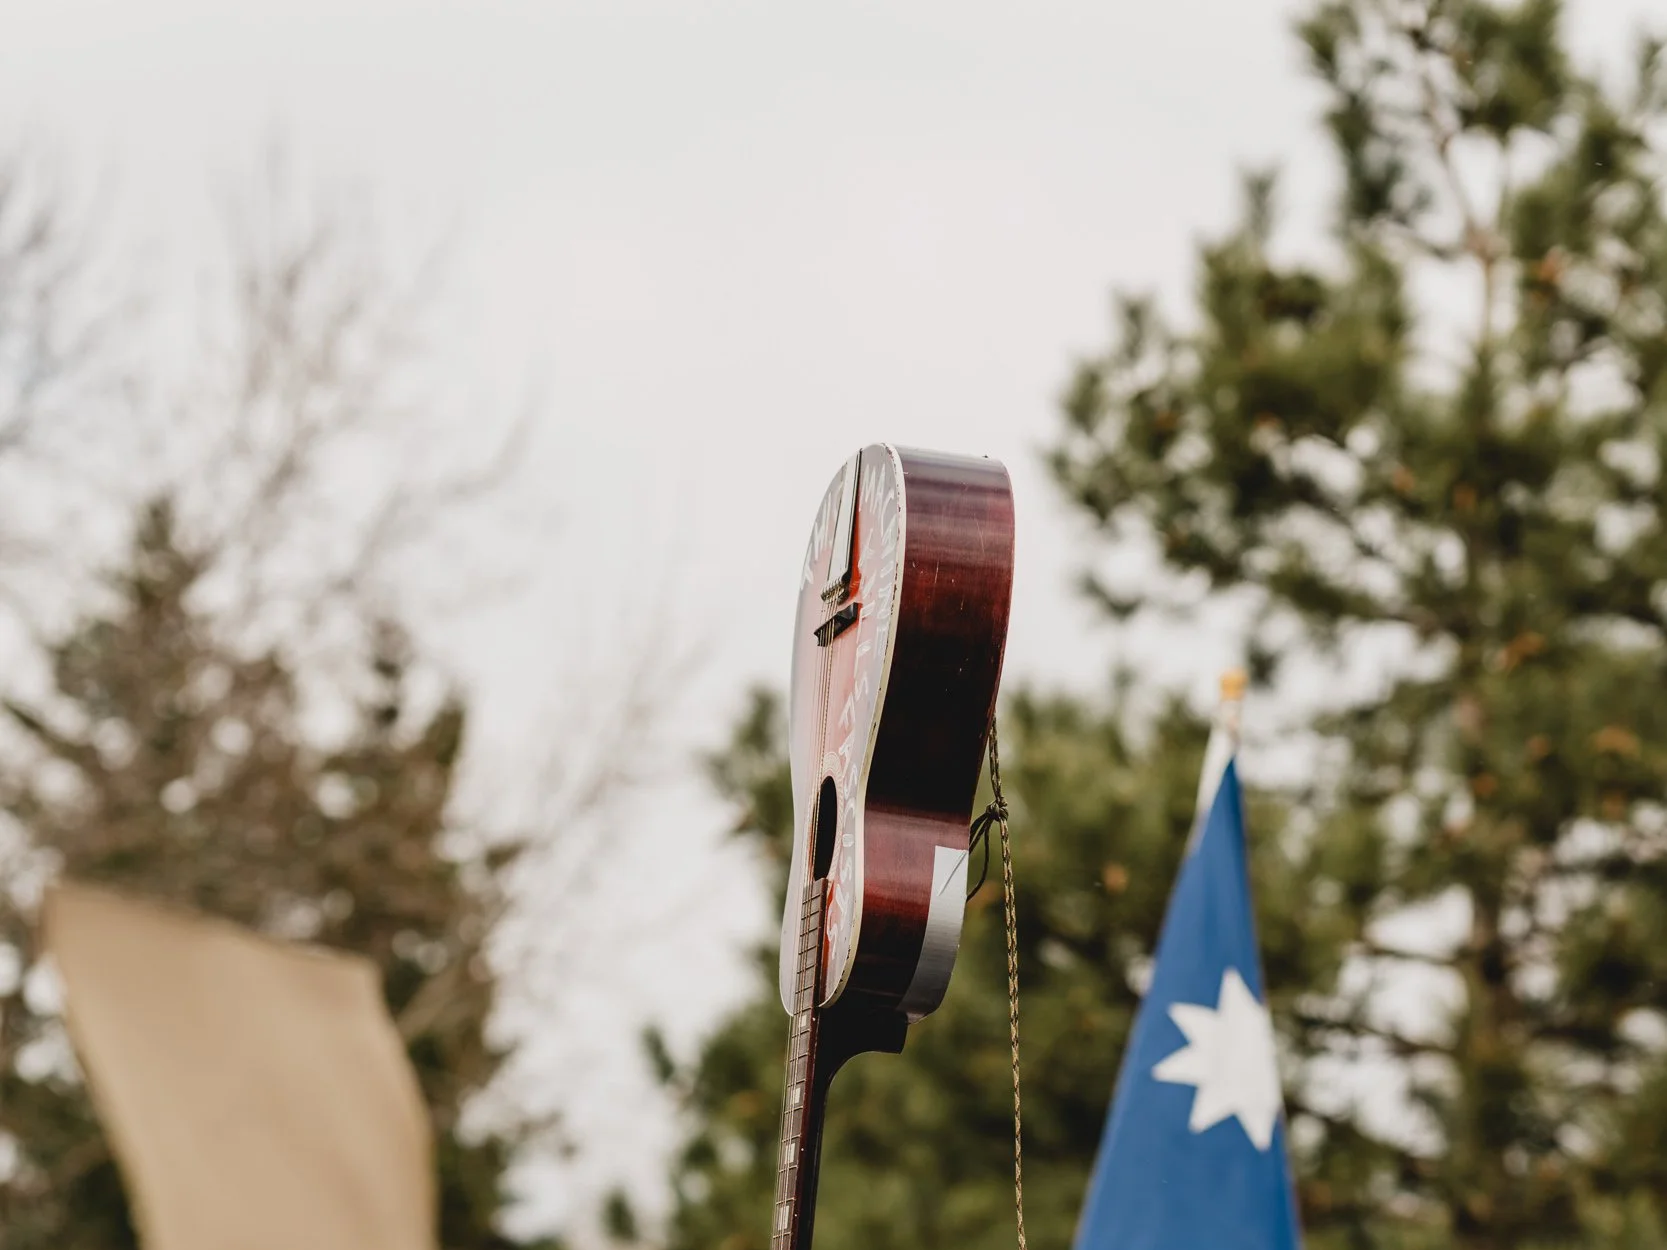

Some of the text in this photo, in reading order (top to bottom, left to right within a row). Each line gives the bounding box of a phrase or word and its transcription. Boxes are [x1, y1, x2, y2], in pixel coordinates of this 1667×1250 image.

[858, 463, 897, 660] MACHINE
[827, 528, 877, 960] KILLS FASCISTS
